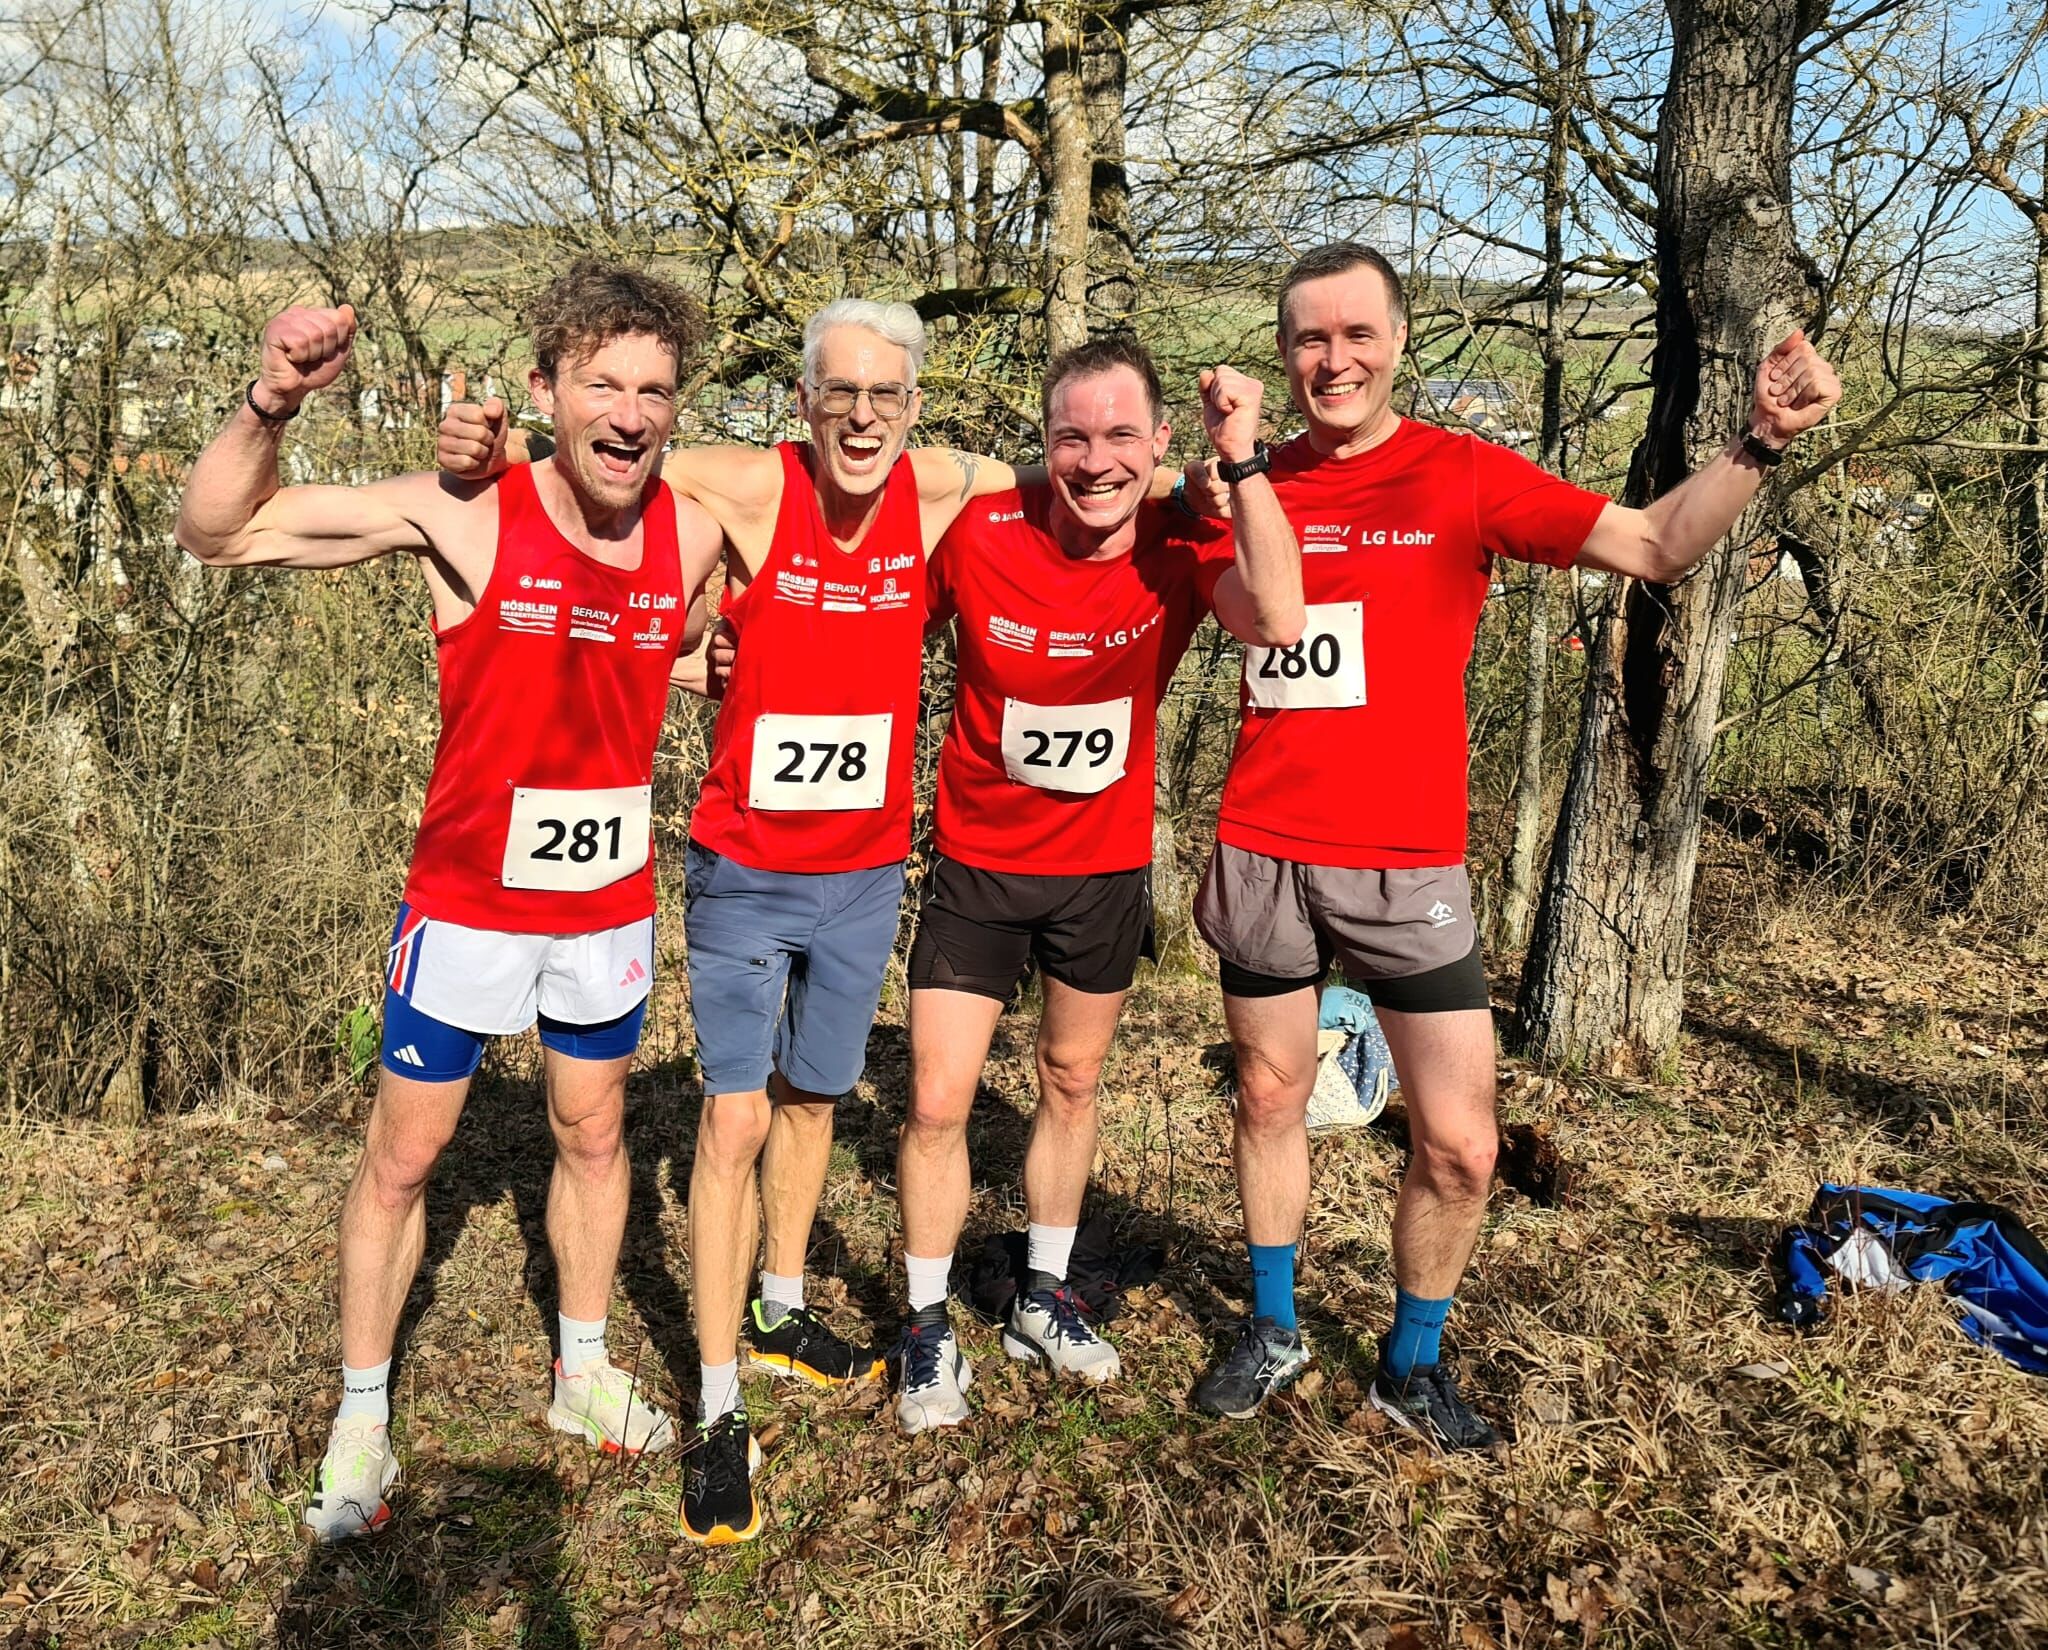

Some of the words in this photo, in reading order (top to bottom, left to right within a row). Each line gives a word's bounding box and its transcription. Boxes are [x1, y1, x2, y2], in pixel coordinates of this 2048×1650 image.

[1001, 510, 1024, 521] JAKO
[1361, 531, 1386, 545] LG
[1393, 530, 1435, 545] Lohr
[885, 553, 915, 571] Lohr
[534, 578, 562, 590] JAKO
[501, 599, 558, 614] MÖSSLEIN
[629, 592, 650, 609] LG
[653, 593, 677, 609] Lohr
[989, 615, 1038, 636] MÖSSLEIN
[1105, 630, 1127, 648] LG
[1259, 633, 1341, 679] 280
[1022, 728, 1114, 768] 279
[773, 741, 867, 784] 278
[530, 816, 622, 863] 281
